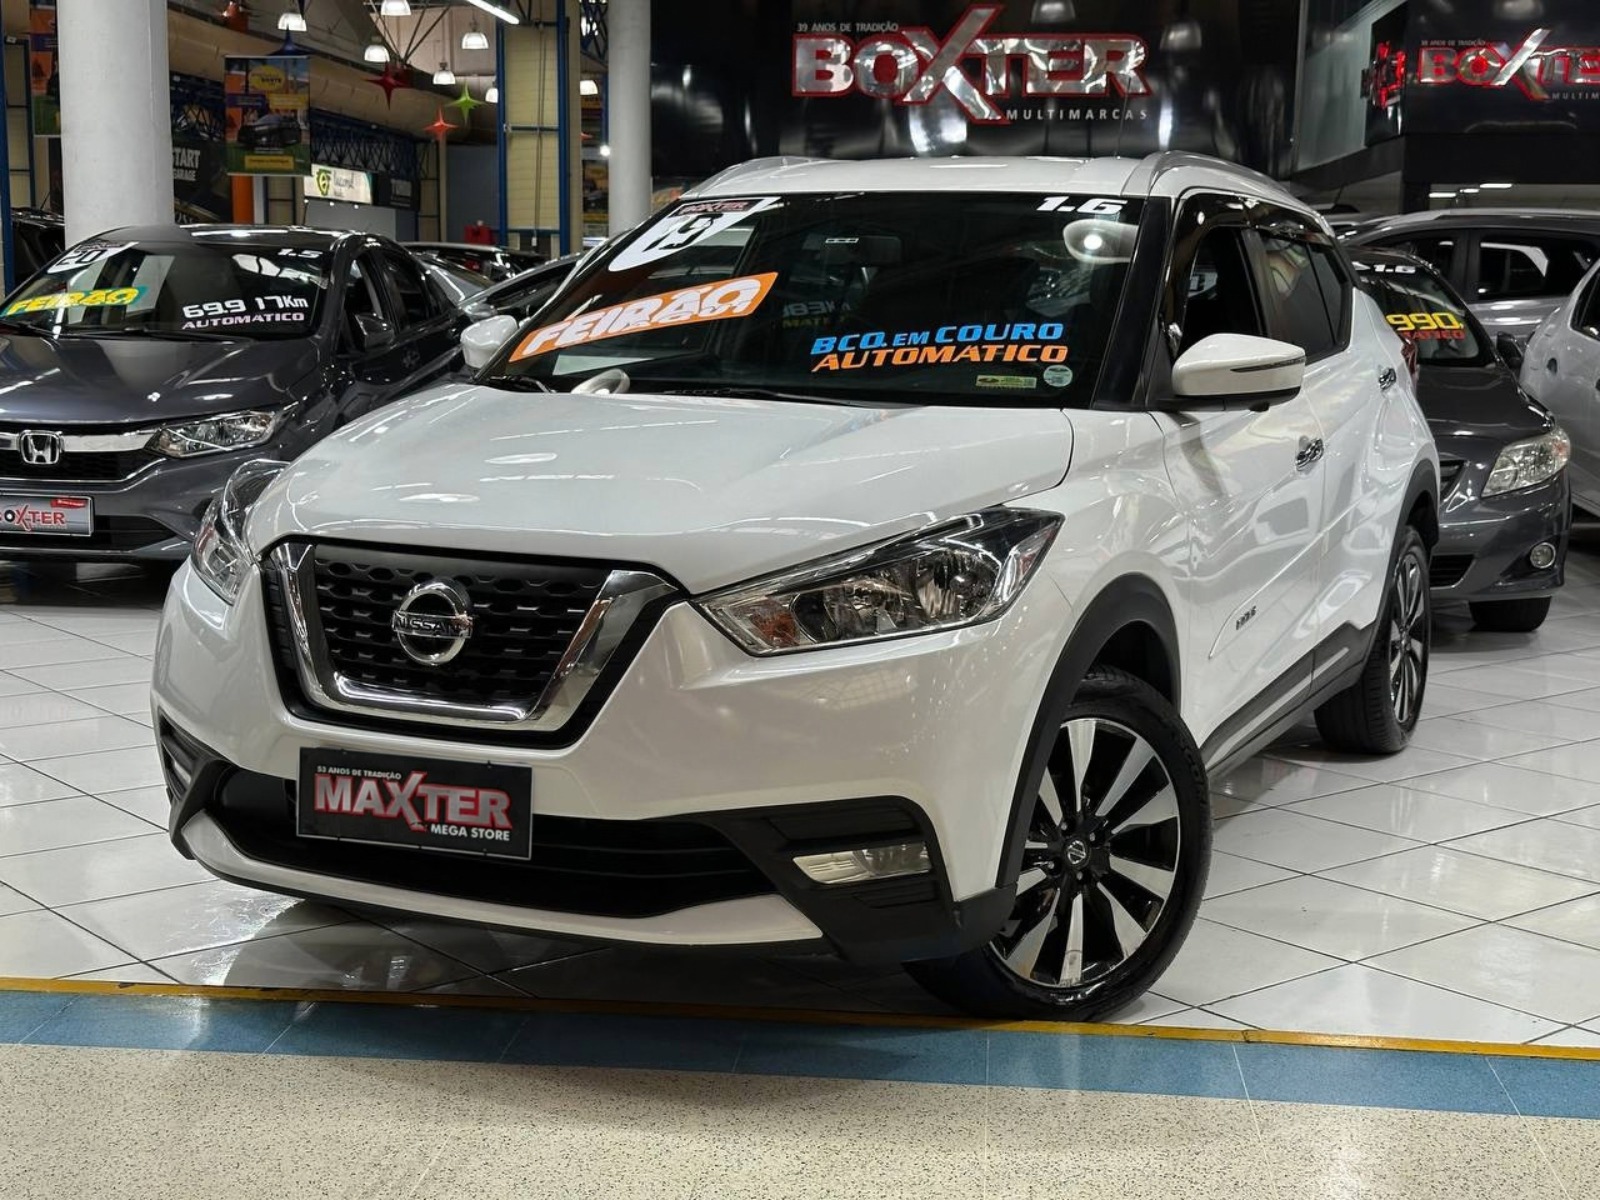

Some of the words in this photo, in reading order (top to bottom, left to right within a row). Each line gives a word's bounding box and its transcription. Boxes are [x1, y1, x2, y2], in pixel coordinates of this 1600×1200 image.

[811, 22, 836, 32] ANOS
[839, 22, 851, 32] DE
[855, 21, 899, 33] TRADIÇÃO
[792, 3, 1152, 125] BOXTER
[1006, 109, 1148, 120] MULTIMARCAS
[173, 147, 201, 169] TART
[1036, 195, 1129, 215] 1.6
[182, 299, 247, 319] 69.9
[521, 278, 762, 356] FEIRÃO
[181, 312, 305, 330] AUTOMATICO
[892, 330, 930, 347] EM
[935, 322, 1064, 344] COURO
[810, 344, 1069, 373] AUTOMATICO
[394, 613, 471, 637] NISSAN
[328, 766, 350, 776] ANOS
[352, 768, 362, 777] DE
[363, 770, 402, 781] TRADIÇÃO
[314, 771, 513, 832] MAXTER
[430, 818, 468, 837] MEGA
[471, 826, 511, 842] STORE
